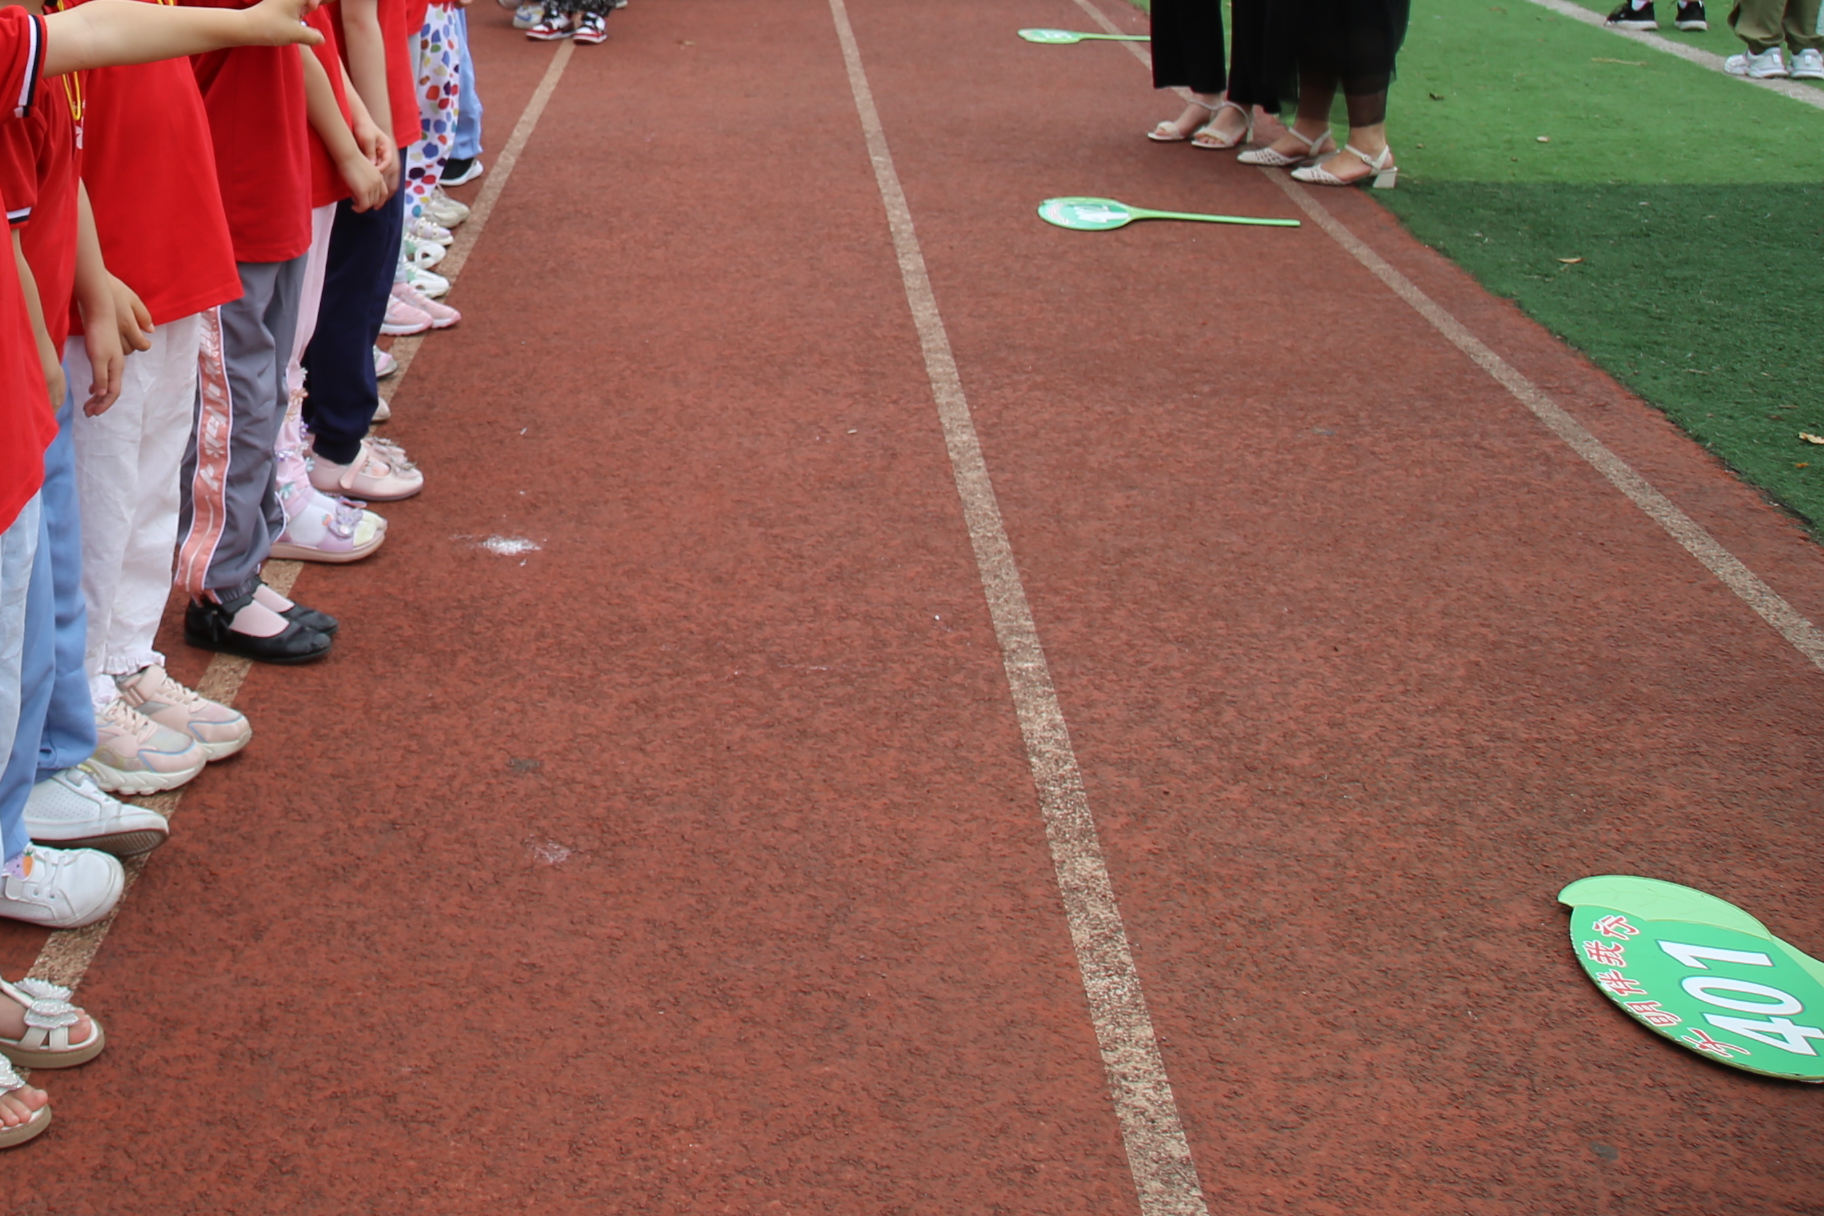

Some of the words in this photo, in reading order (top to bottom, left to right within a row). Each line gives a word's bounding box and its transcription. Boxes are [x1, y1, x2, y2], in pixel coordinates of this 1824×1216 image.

[1582, 915, 1753, 1058] 文明伴我行
[1658, 939, 1824, 1057] 401
